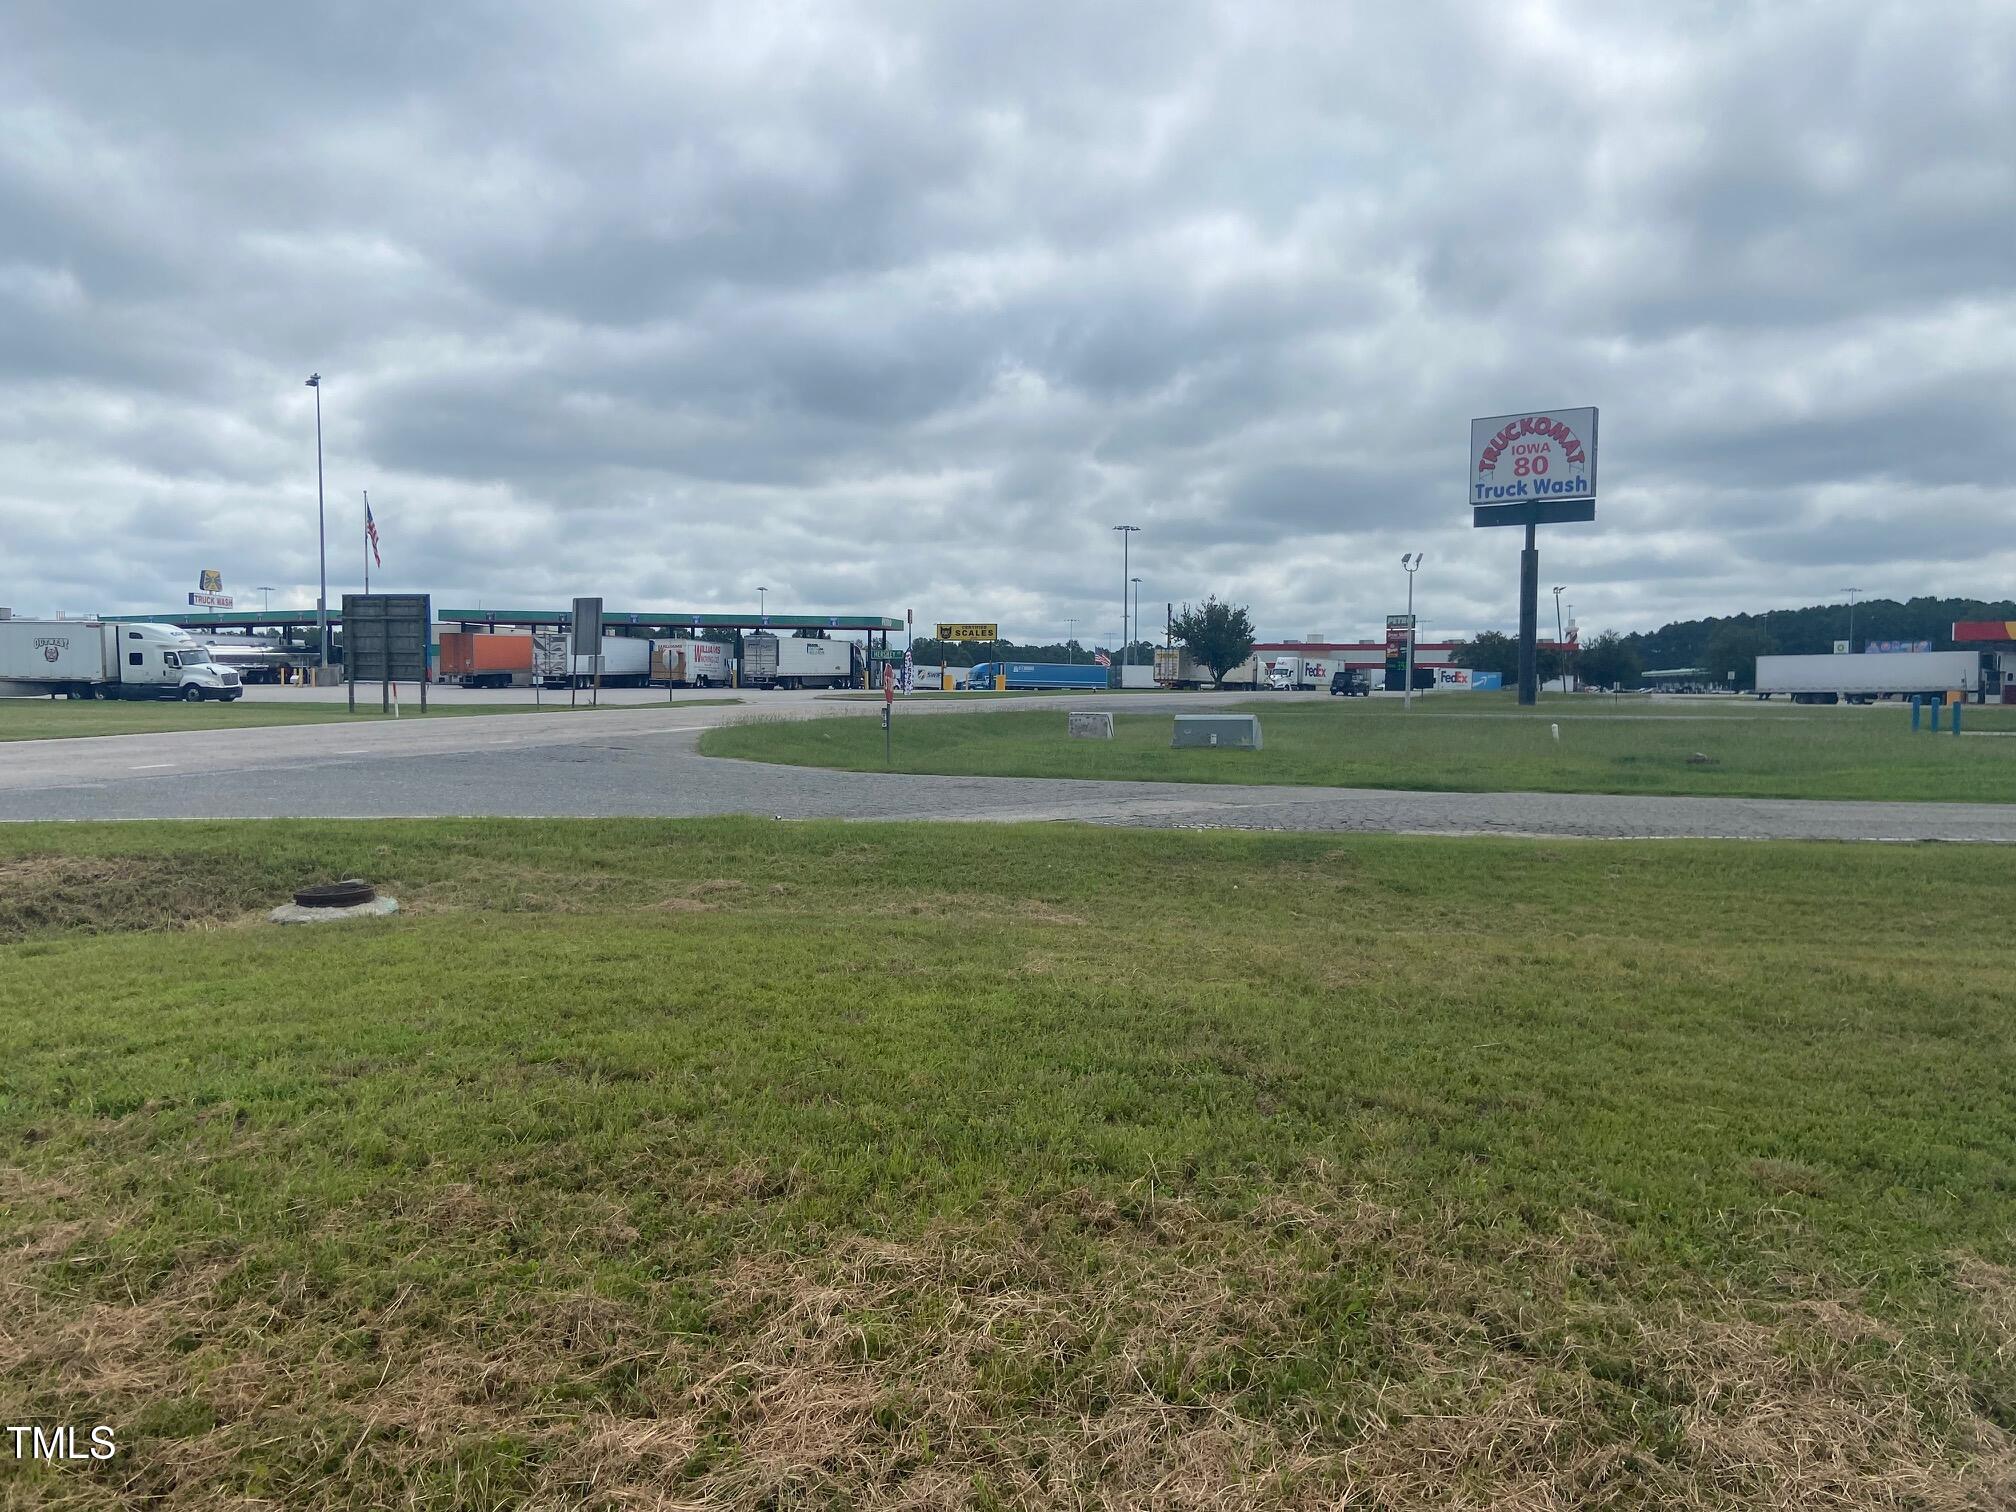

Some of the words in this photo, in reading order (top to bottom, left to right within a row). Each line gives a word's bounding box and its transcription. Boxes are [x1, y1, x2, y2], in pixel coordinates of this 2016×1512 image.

[1479, 417, 1585, 472] TRUCKOMAT
[1511, 442, 1551, 456] IOWA
[1513, 455, 1549, 477] 80
[1475, 480, 1528, 499] Truck
[1533, 475, 1588, 495] Wash
[194, 595, 215, 605] TRUCK
[216, 597, 233, 607] WASH
[955, 629, 994, 637] SCALES
[1305, 662, 1327, 678] FedEx
[1441, 670, 1468, 684] FedEx
